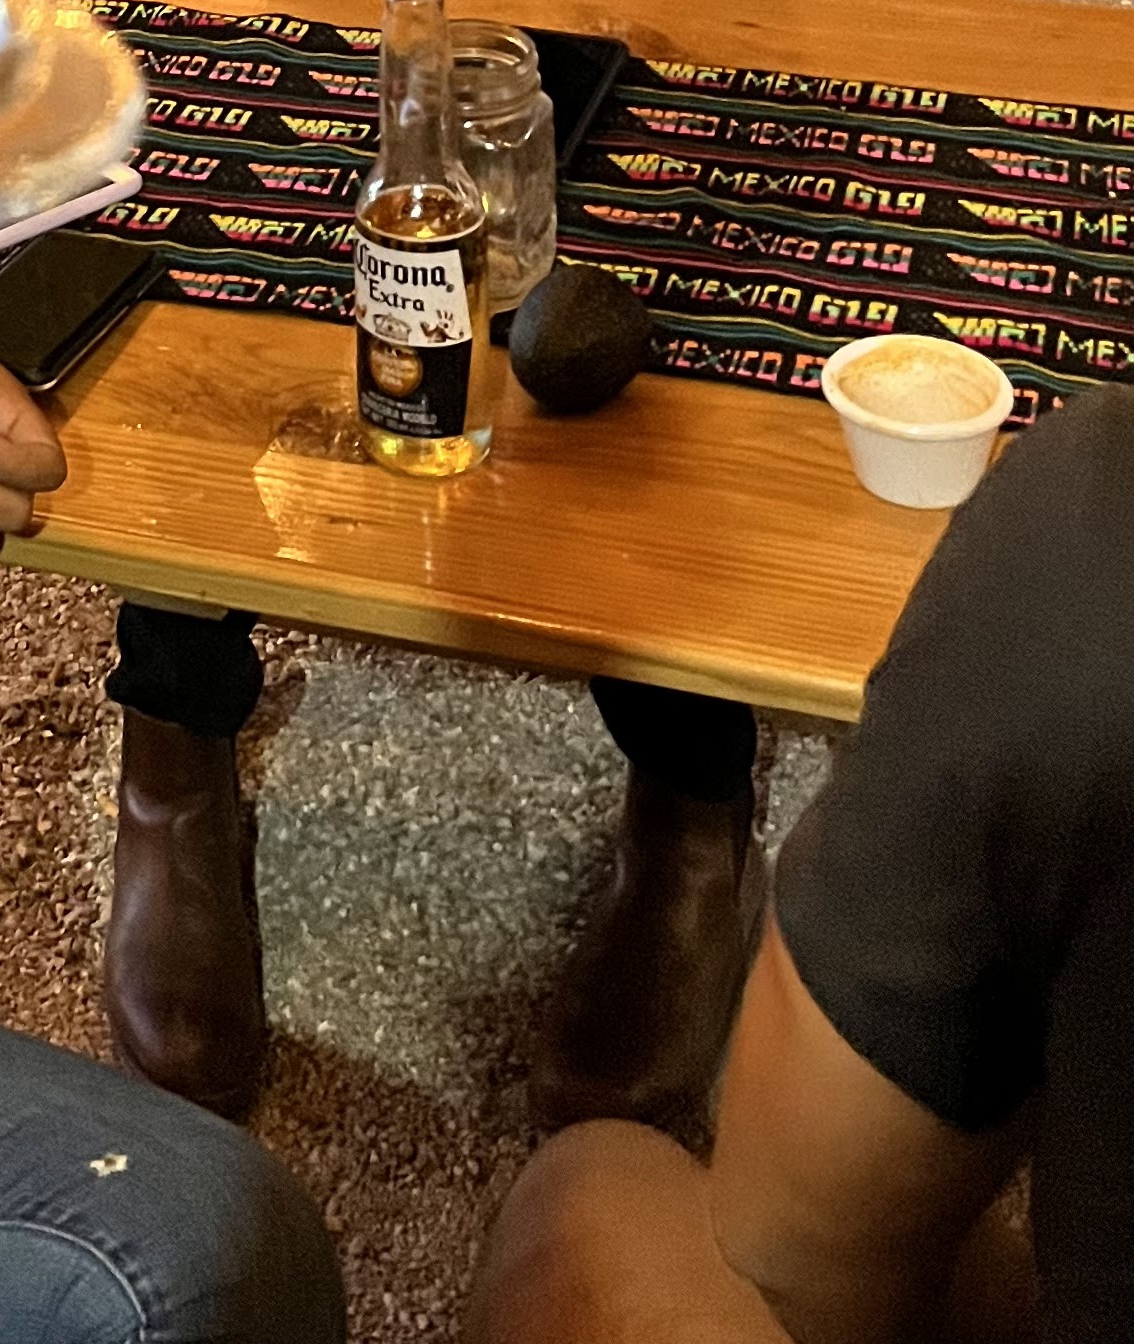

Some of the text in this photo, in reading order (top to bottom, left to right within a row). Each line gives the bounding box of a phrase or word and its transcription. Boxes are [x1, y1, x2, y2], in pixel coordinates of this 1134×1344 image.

[742, 69, 863, 103] MEXICO
[726, 118, 849, 151] MEXICO
[707, 167, 836, 202] MEXICO
[686, 215, 821, 261] MEXICO
[356, 240, 447, 287] Corona
[368, 278, 425, 312] Extra
[664, 272, 802, 316] MEXICO
